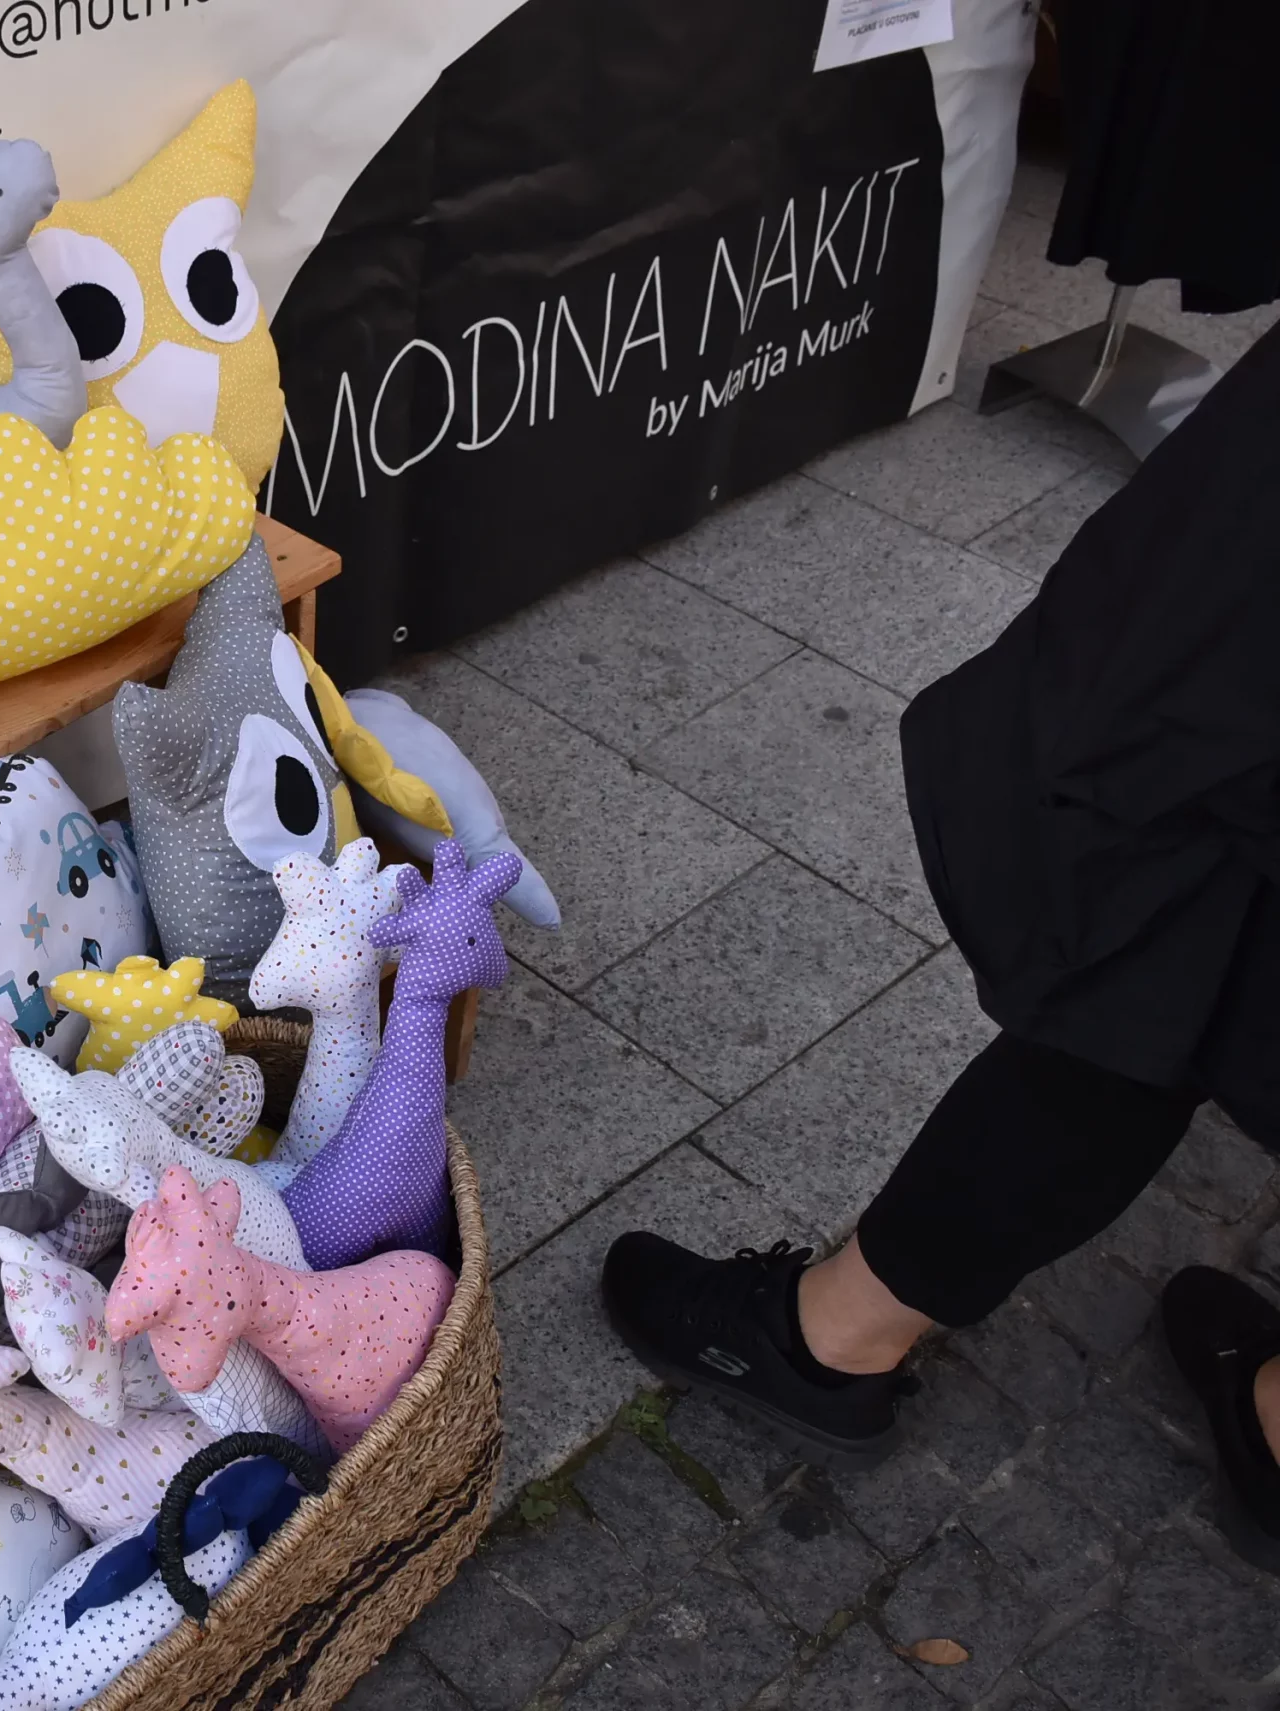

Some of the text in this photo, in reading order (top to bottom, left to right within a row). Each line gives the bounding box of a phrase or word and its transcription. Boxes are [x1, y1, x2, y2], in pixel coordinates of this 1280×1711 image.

[265, 158, 919, 516] MODINA NAKIT
[646, 300, 875, 438] by Marija Murk
